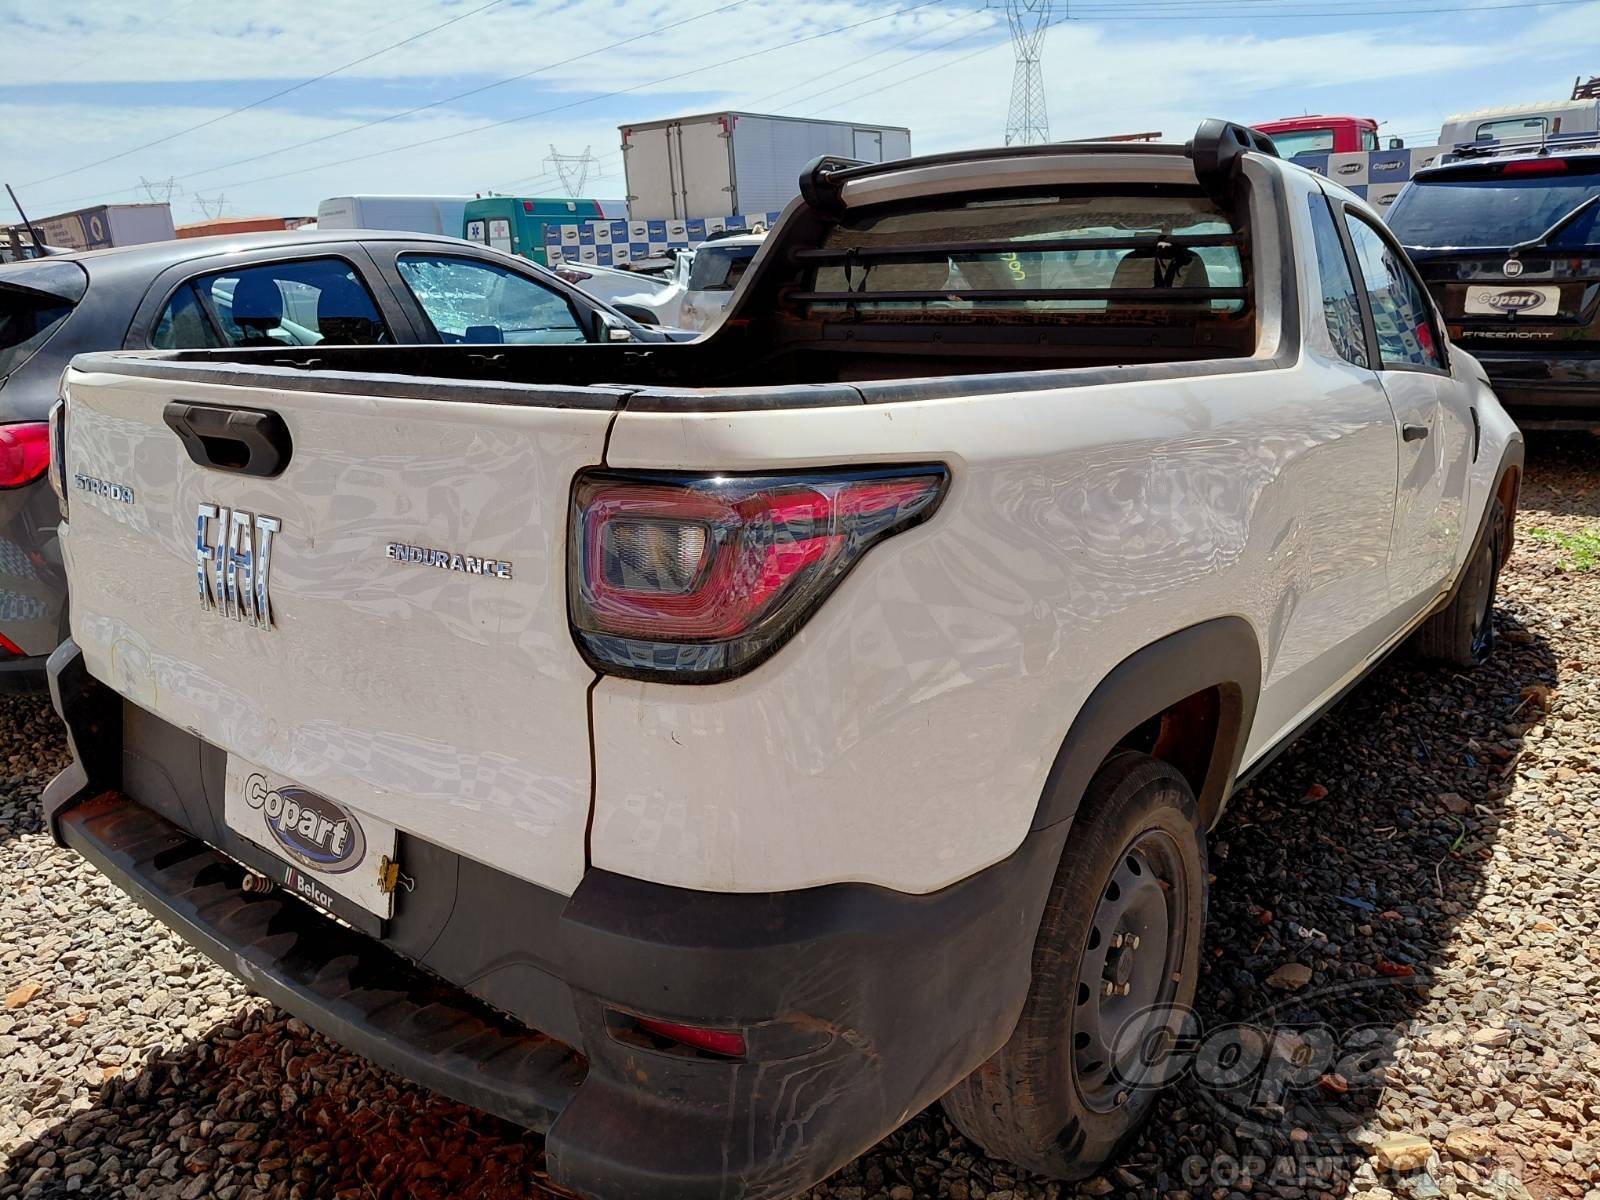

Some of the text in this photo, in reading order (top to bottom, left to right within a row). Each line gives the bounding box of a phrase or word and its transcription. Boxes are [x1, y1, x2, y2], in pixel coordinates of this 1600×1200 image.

[1478, 292, 1537, 306] Copart
[1463, 331, 1554, 339] FREEMONT
[75, 473, 135, 504] STRADA
[197, 502, 282, 632] FIAT
[385, 542, 513, 580] ENDURANCE
[245, 773, 350, 858] Copart
[296, 874, 334, 908] Belcar
